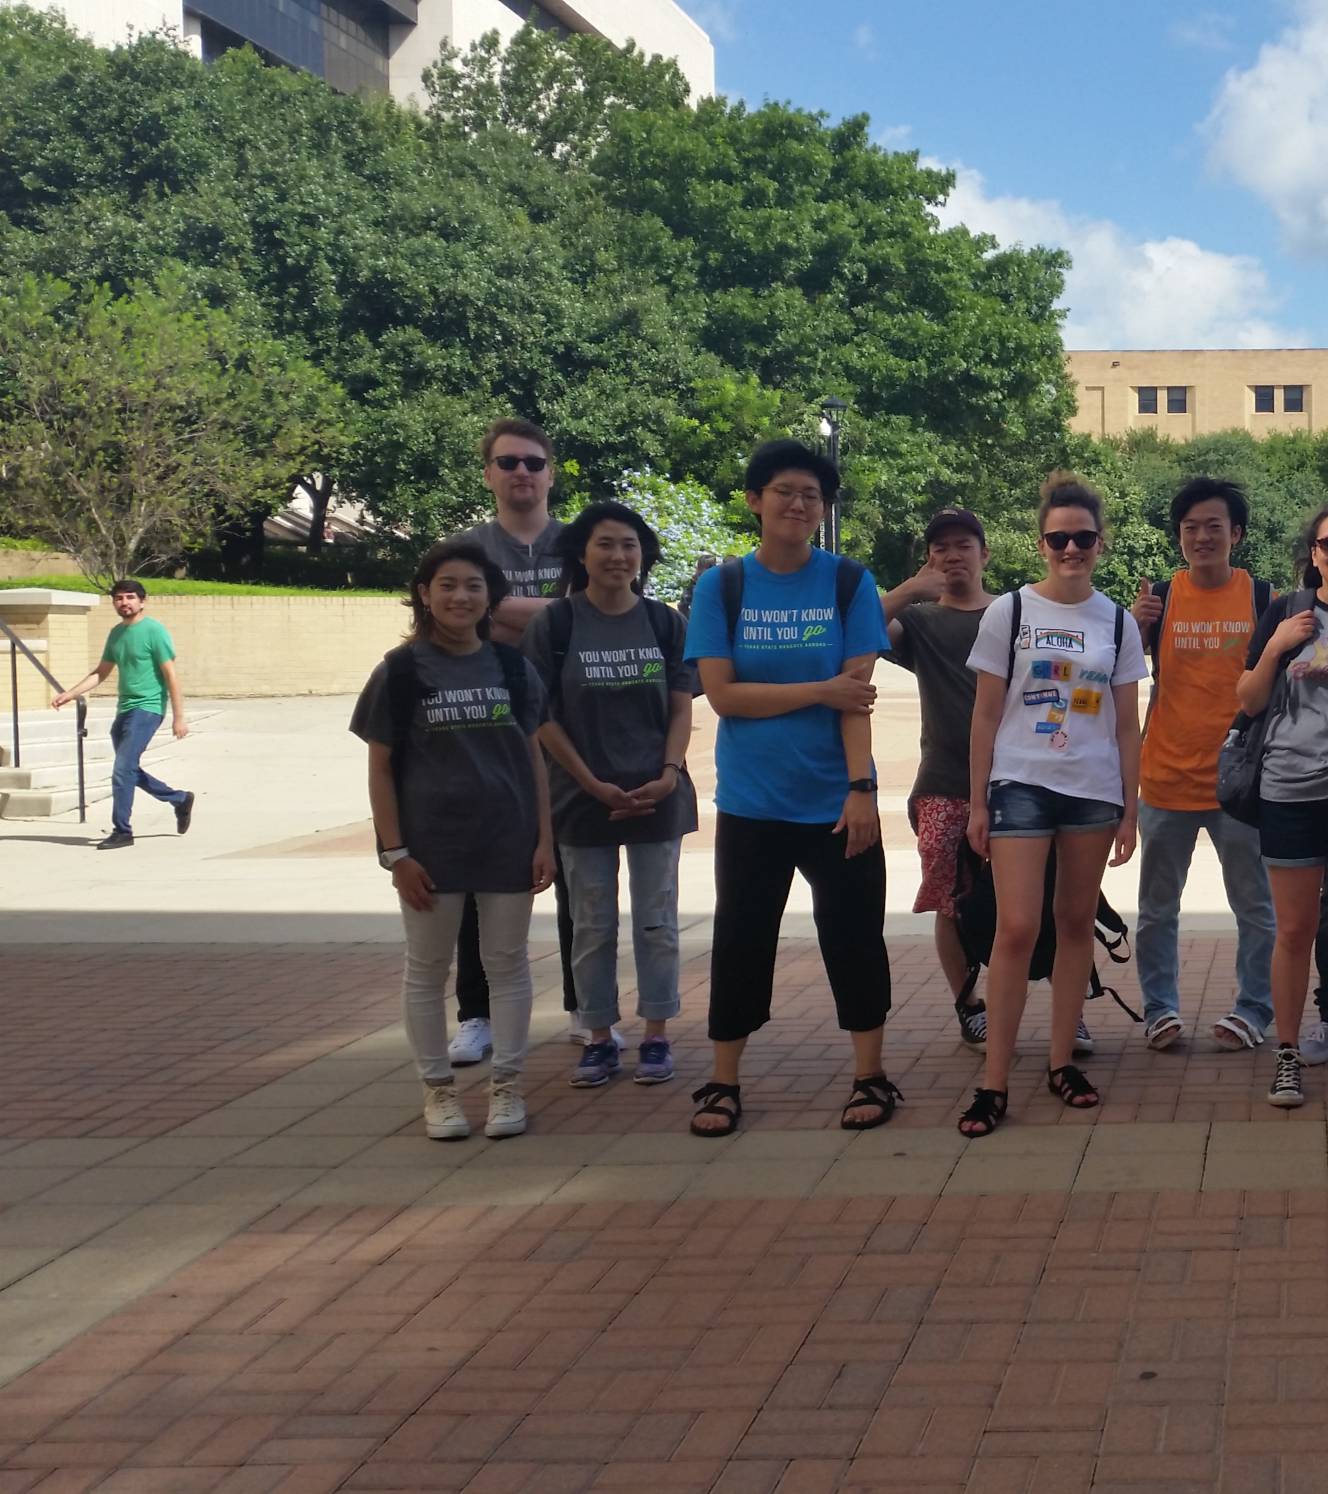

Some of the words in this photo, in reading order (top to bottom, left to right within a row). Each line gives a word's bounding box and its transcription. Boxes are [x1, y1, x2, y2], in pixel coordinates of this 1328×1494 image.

[761, 609, 798, 623] WON'T
[801, 607, 834, 622] KNOW
[743, 626, 773, 641] UNTIL
[776, 626, 798, 640] YOU
[802, 624, 827, 641] go
[1172, 621, 1189, 633] YOU
[1191, 621, 1221, 633] WON'T
[1223, 621, 1250, 633] KNOW
[1046, 635, 1074, 649] ALOHA
[1174, 637, 1201, 649] UNTIL
[1203, 637, 1220, 649] YOU
[579, 650, 600, 663] YOU
[601, 649, 635, 663] WON'T
[585, 665, 616, 679] UNTIL
[617, 663, 639, 678] YOU
[642, 662, 663, 678] go
[444, 688, 483, 703] WON'T
[485, 687, 511, 701] KNO
[427, 706, 462, 723] UNTIL
[463, 704, 487, 720] YOU
